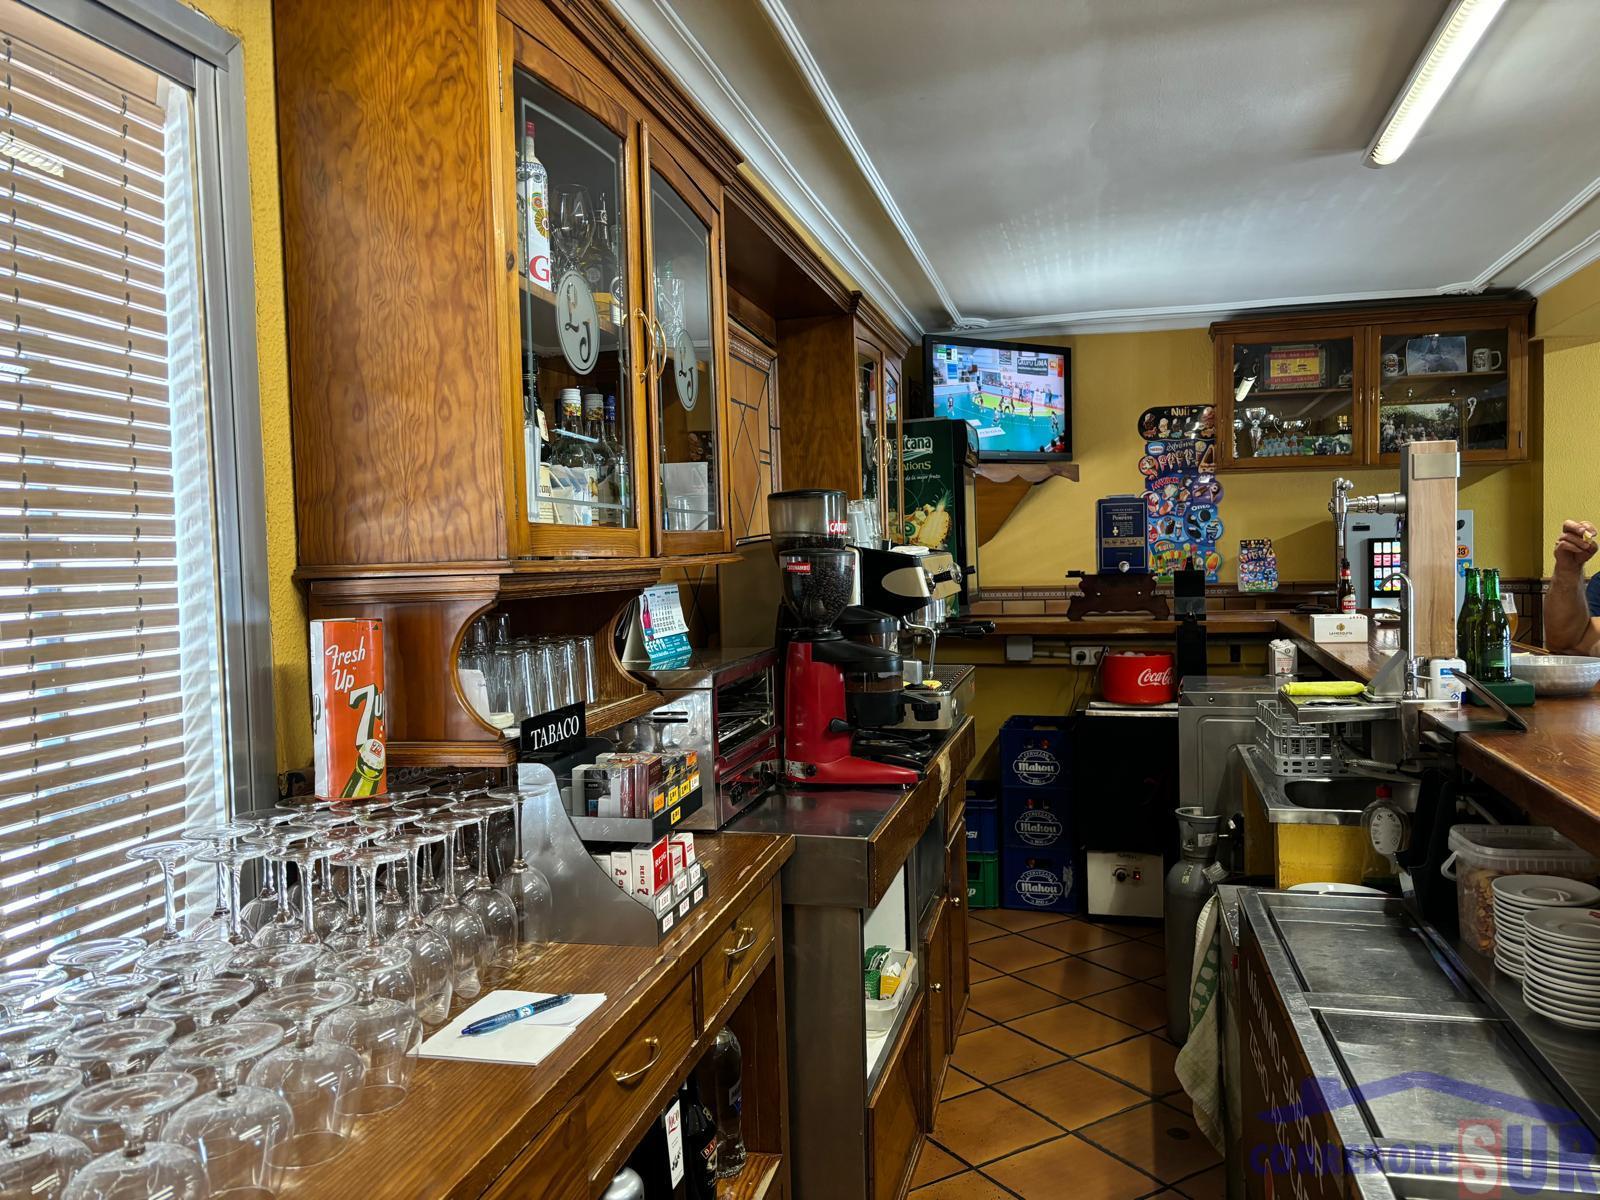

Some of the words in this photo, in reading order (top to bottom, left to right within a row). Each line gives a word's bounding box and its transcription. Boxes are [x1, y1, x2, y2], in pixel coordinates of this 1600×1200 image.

[326, 636, 366, 670] Fresh
[332, 669, 355, 693] Up
[530, 715, 580, 751] TABACO
[1018, 762, 1055, 772] Mahou
[1020, 822, 1057, 833] Mahou
[1021, 882, 1058, 893] Mahou
[1271, 1091, 1310, 1200] AZÚCA
